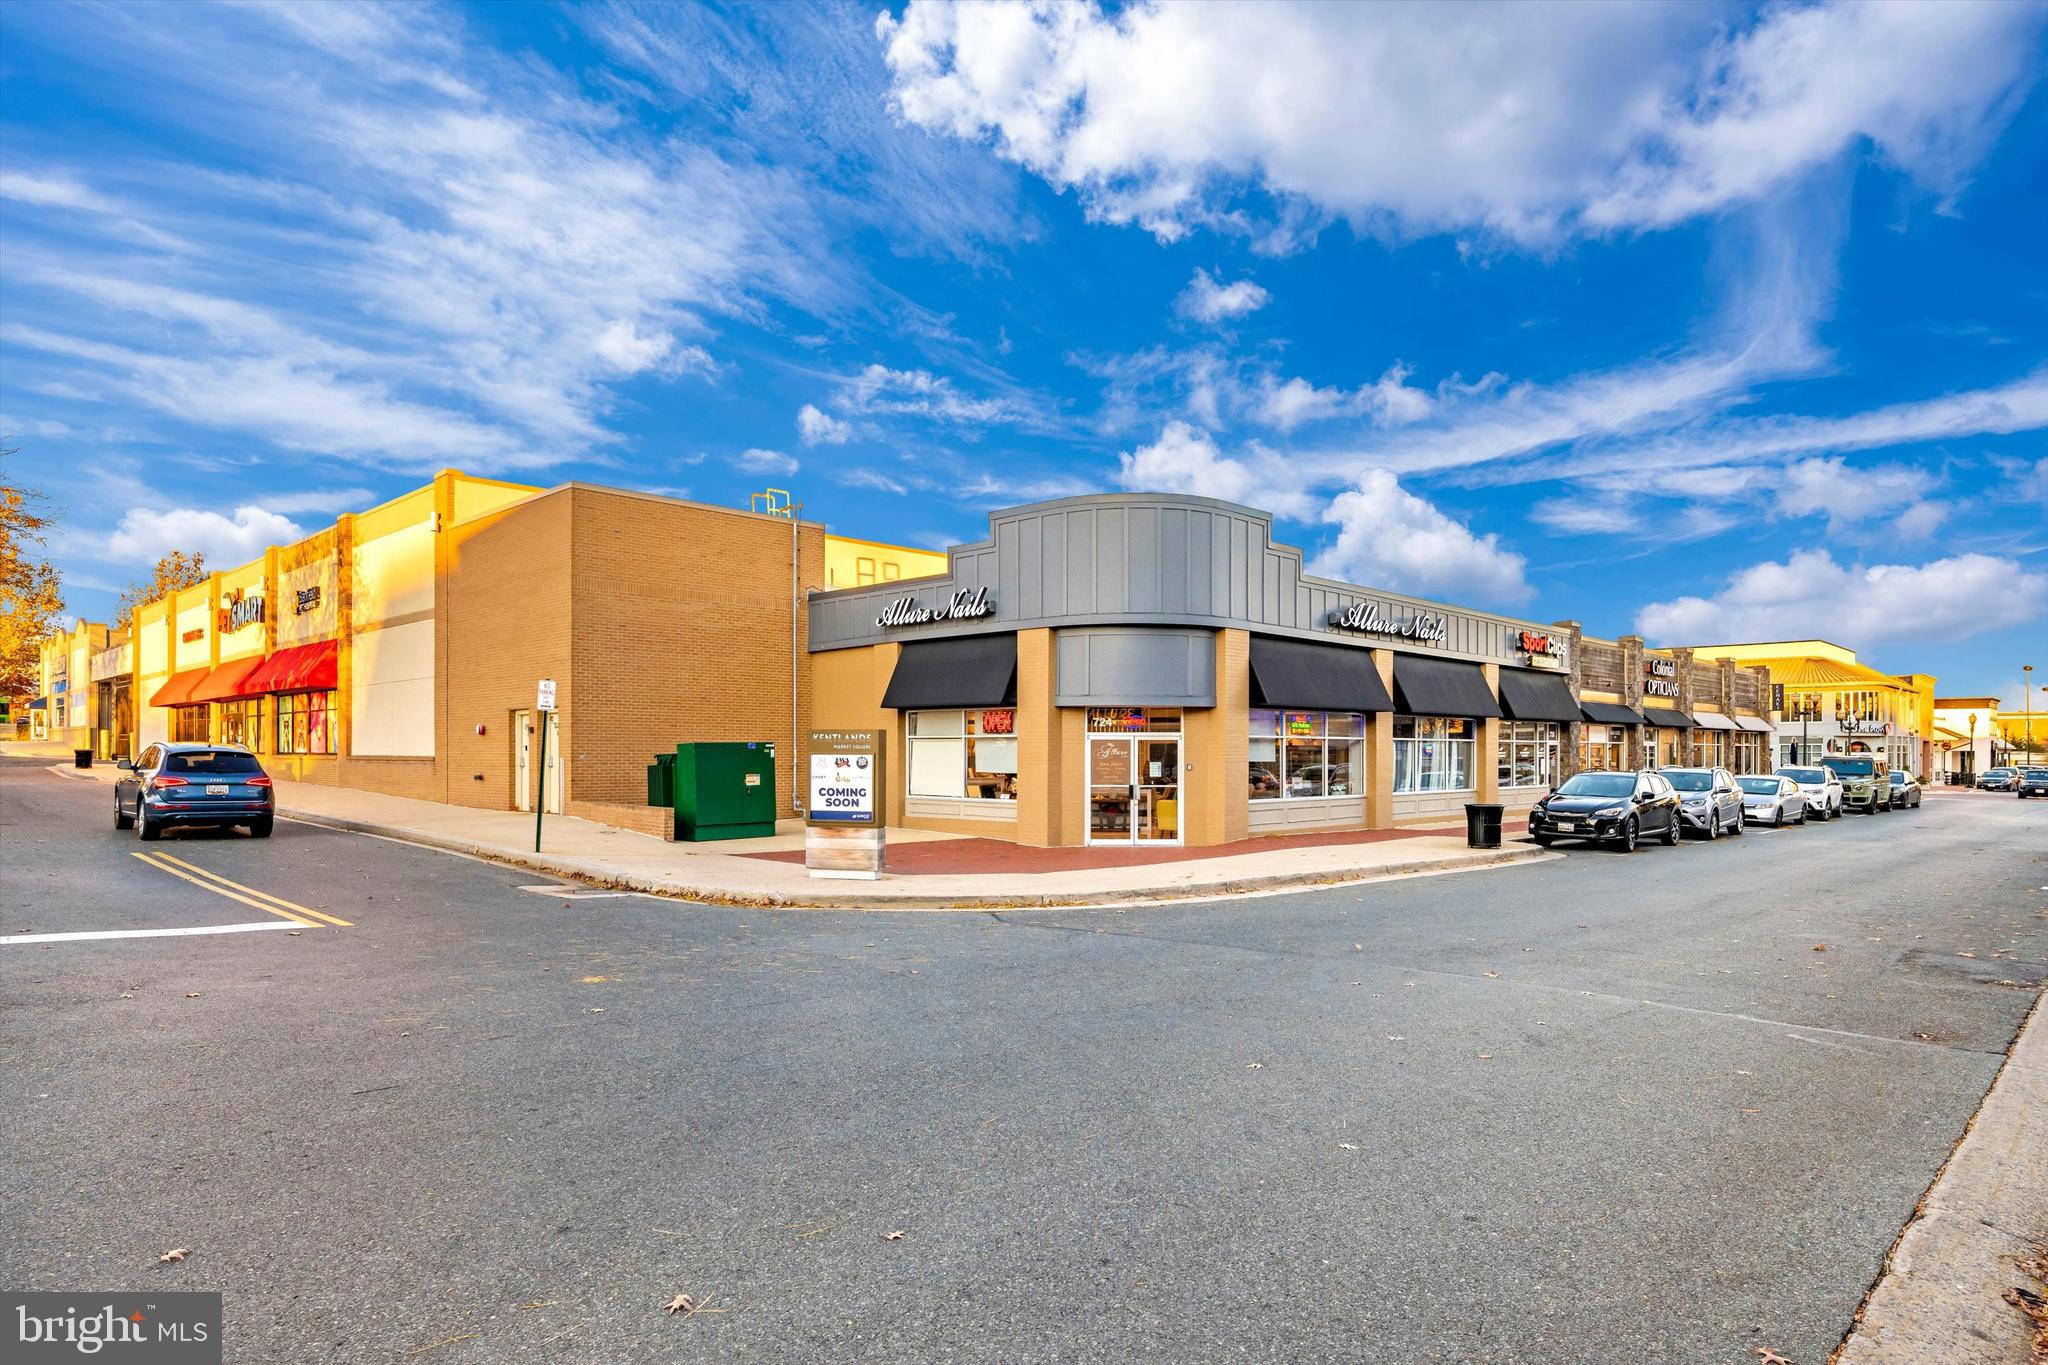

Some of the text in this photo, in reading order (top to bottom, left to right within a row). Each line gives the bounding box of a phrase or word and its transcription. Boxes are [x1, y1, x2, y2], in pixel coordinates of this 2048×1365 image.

[875, 586, 988, 627] Allure Nails
[1340, 602, 1448, 642] Allure Nails
[1652, 659, 1675, 677] Colonial
[1648, 679, 1679, 697] OPTICIANS
[984, 713, 1011, 731] OPEN
[1092, 717, 1113, 727] 724
[818, 787, 867, 798] COMING
[825, 797, 860, 808] SOON
